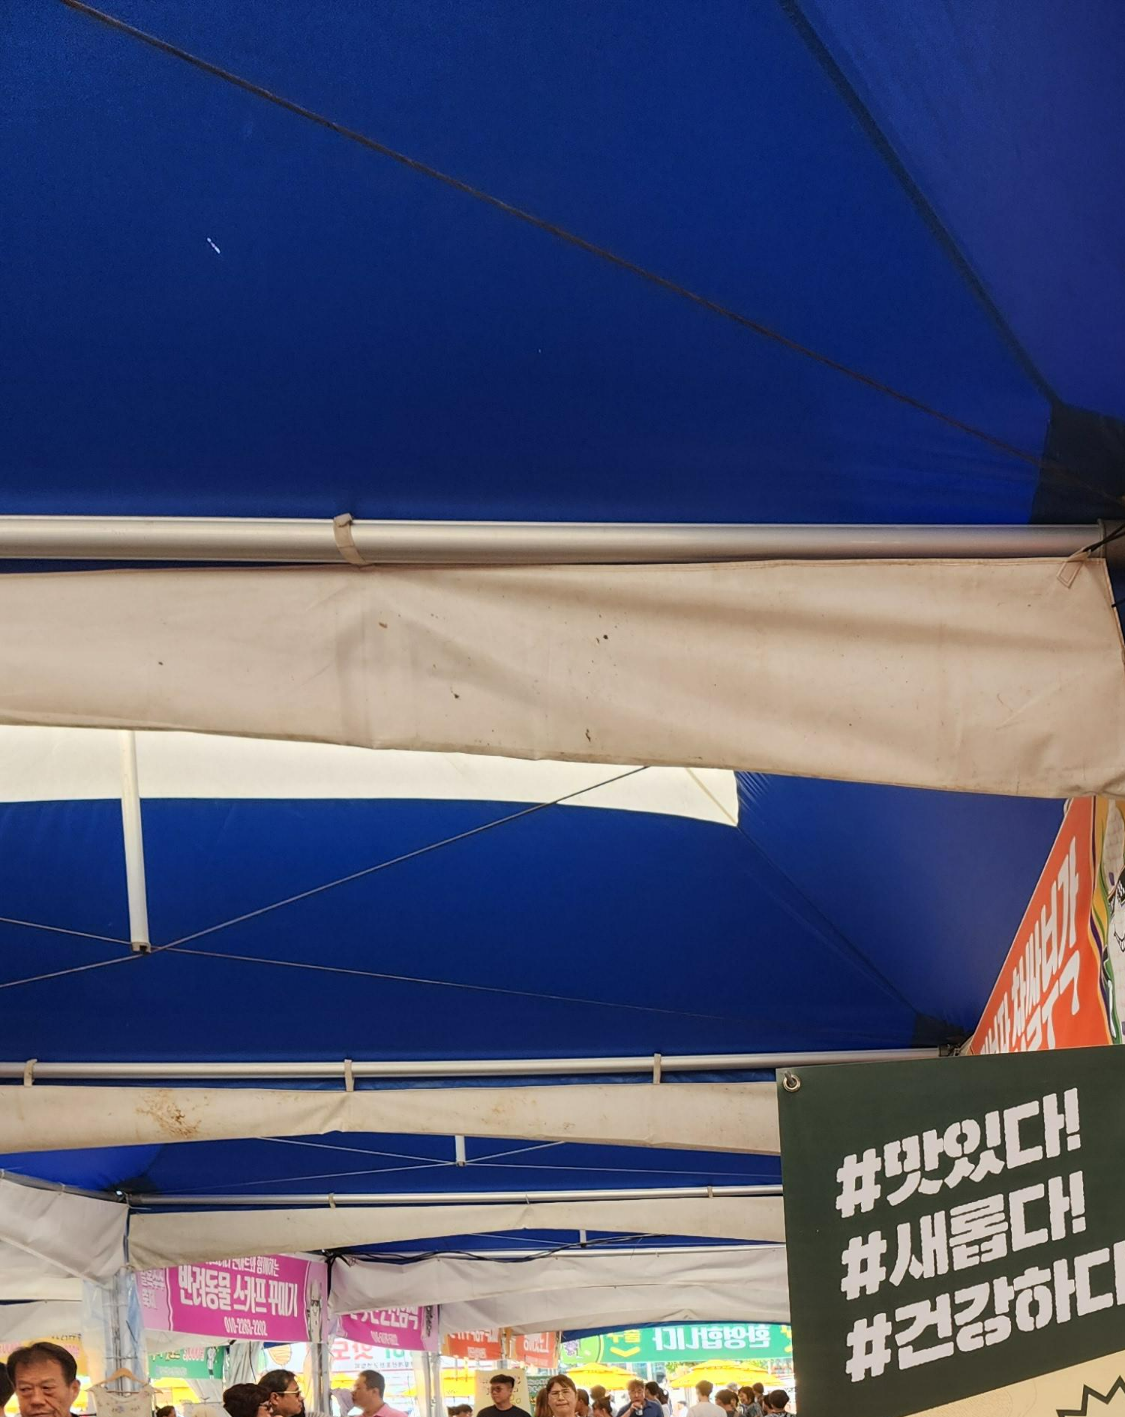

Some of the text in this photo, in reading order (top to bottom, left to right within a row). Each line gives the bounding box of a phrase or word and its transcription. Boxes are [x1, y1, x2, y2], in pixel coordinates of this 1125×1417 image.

[835, 1086, 1082, 1219] #맛있다!
[178, 1264, 299, 1318] 반려동물 스카프 꾸미기
[840, 1170, 1087, 1300] #새롭다!
